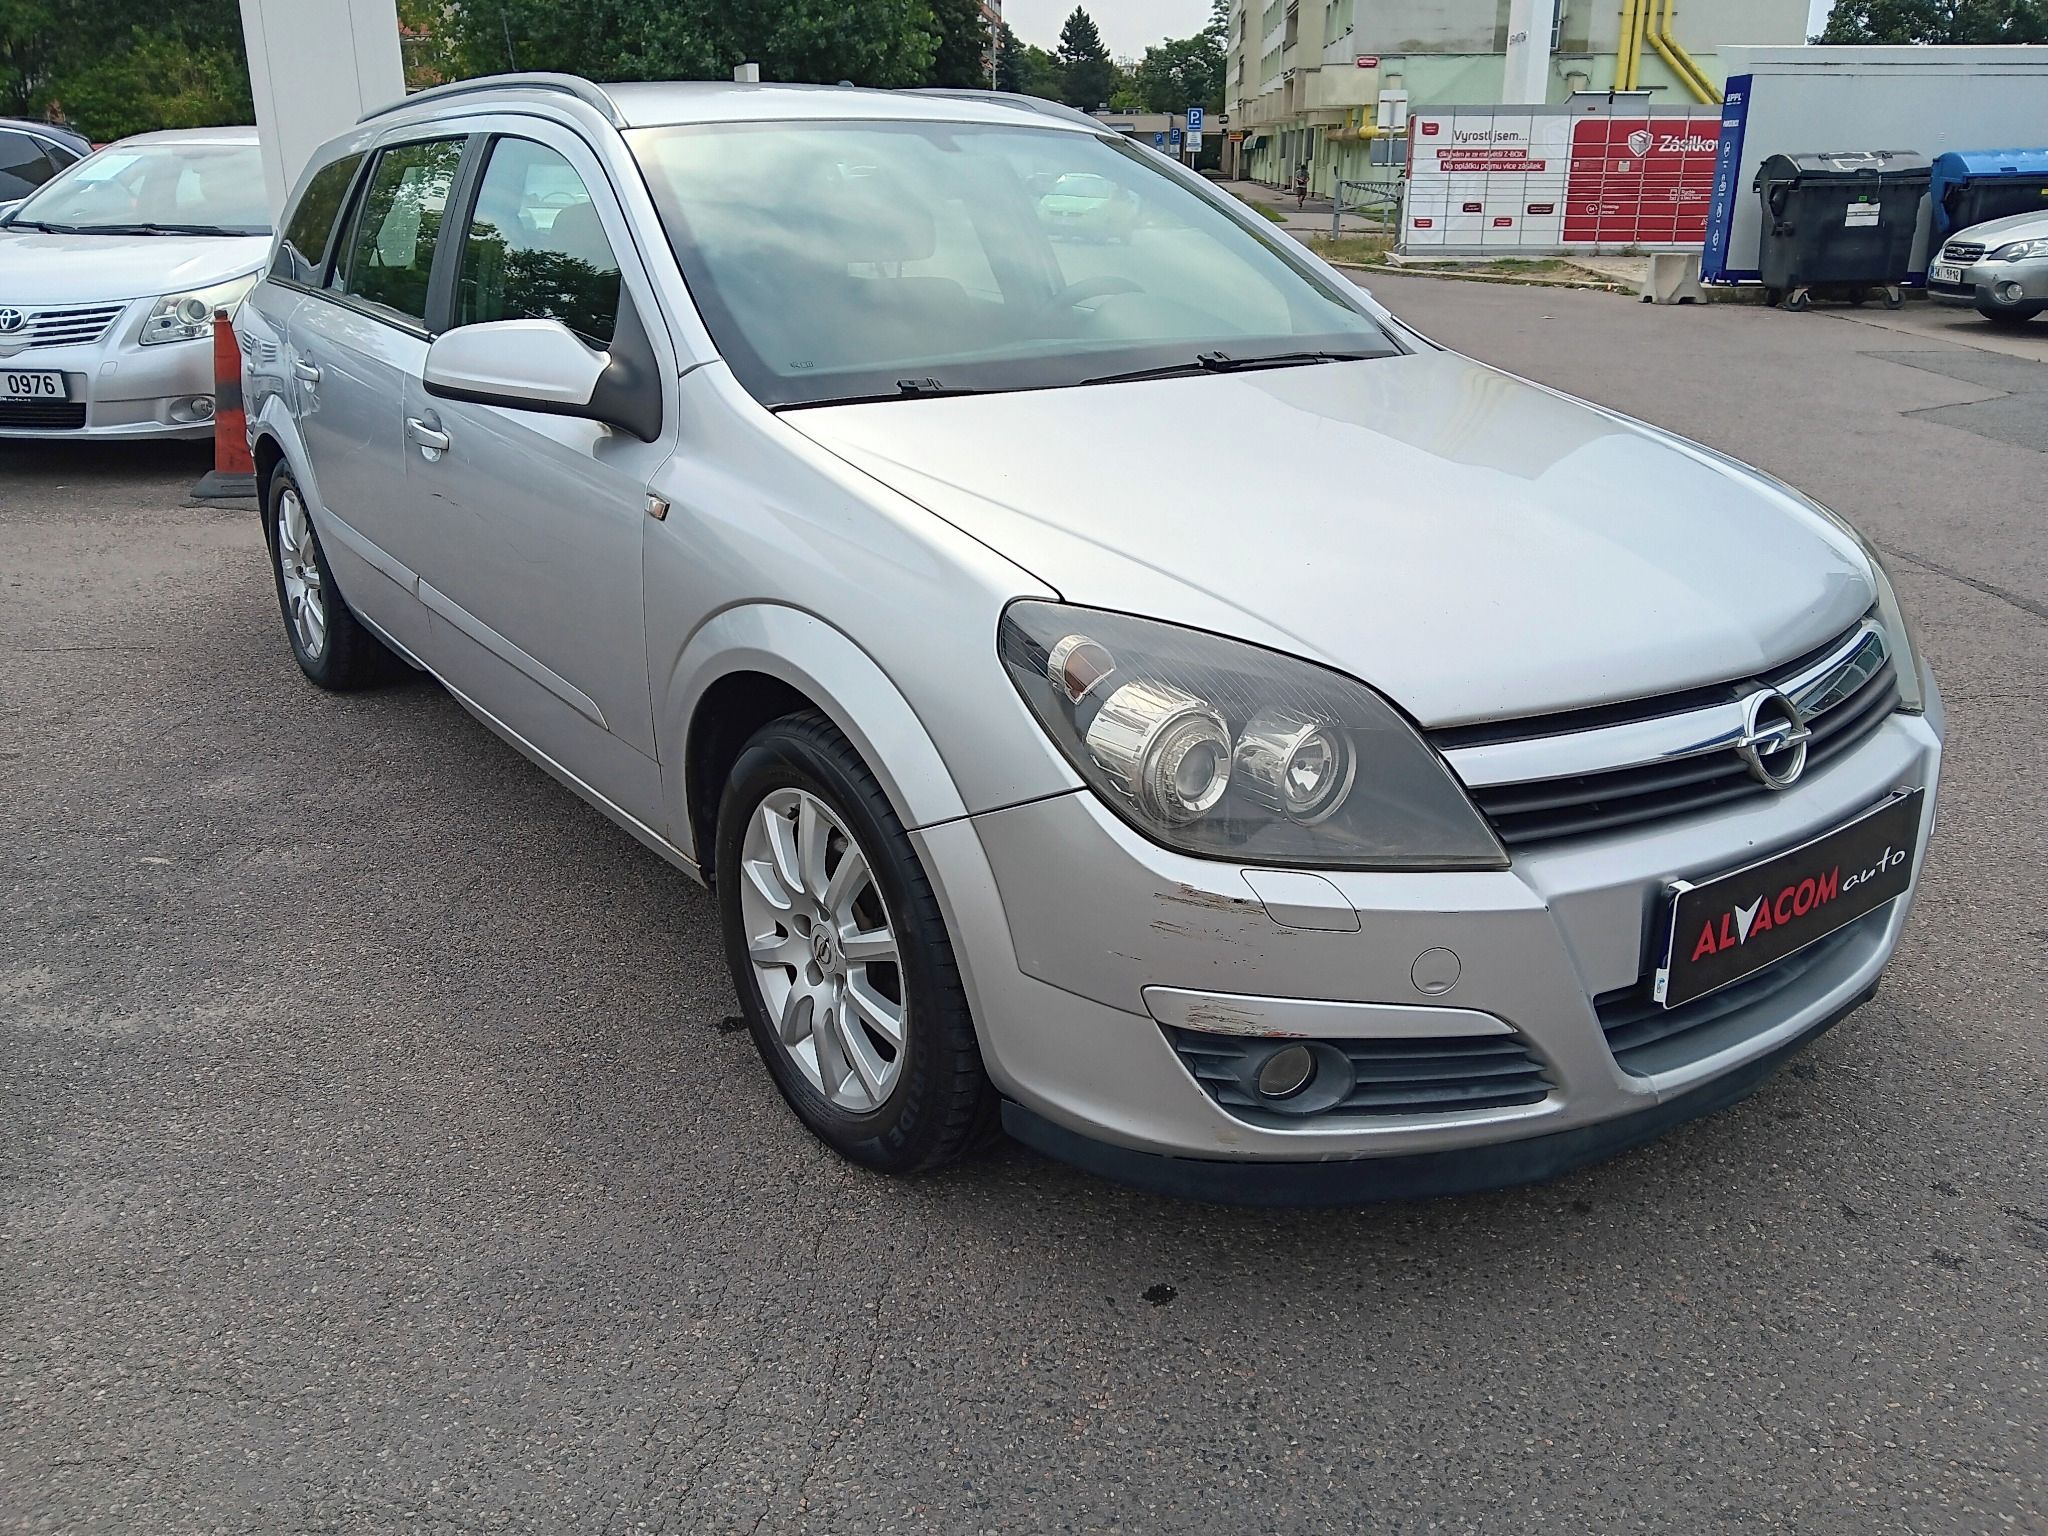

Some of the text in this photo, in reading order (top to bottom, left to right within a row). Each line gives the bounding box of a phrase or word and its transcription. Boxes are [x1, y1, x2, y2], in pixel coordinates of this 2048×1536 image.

[1190, 111, 1200, 124] P
[1454, 130, 1528, 143] Vyrostl jsem...
[1443, 161, 1453, 169] Na
[1503, 161, 1517, 169] více
[7, 374, 56, 395] 0976
[1691, 845, 1906, 962] ALVACOM auto
